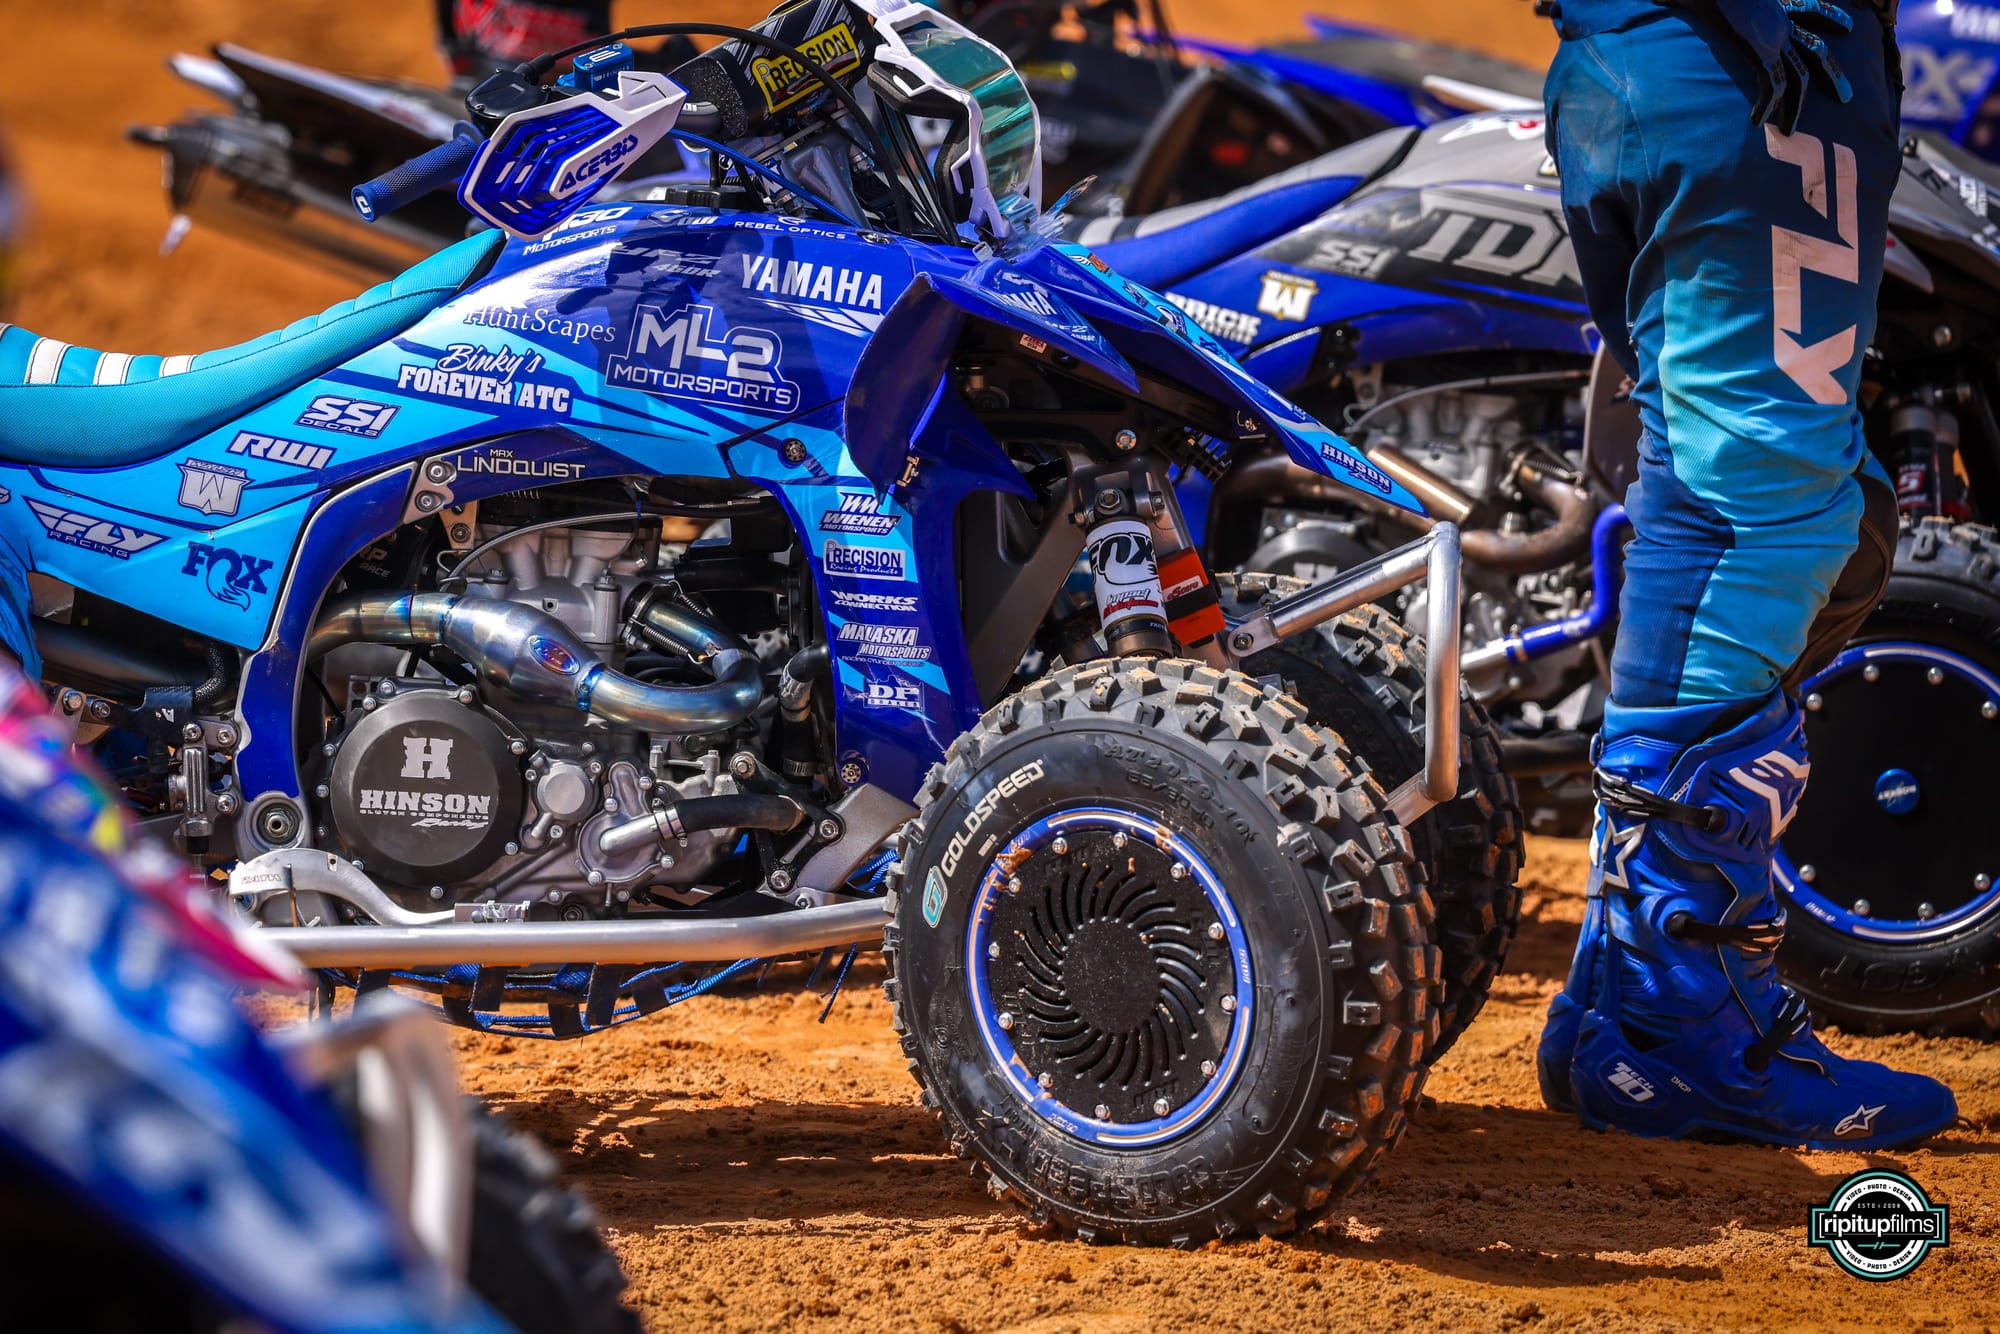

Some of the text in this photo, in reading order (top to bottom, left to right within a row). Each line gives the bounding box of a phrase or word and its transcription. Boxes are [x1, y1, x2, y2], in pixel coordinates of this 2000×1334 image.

[755, 30, 855, 95] PRECSION
[559, 134, 639, 193] ACERBIS
[522, 225, 617, 256] MOTORSPORTS
[734, 221, 846, 240] REBEL OPTICS
[741, 253, 882, 310] YAMAHA
[463, 306, 616, 345] HuntScapes
[635, 312, 775, 384] ML2
[438, 344, 543, 385] Binky's
[397, 365, 571, 413] FOREVER ATC
[613, 363, 792, 406] MOTORSPORTS
[299, 417, 379, 437] DECALS
[302, 397, 396, 431] SSI
[457, 455, 586, 478] LINDQUIST
[489, 448, 513, 458] MAX
[1323, 443, 1390, 487] HINSON
[45, 506, 165, 552] FLY
[822, 523, 888, 534] MOTORSPORTS
[823, 511, 898, 528] WIENEN
[50, 531, 128, 558] RACING
[826, 541, 901, 568] PRECISION
[181, 540, 274, 604] FOX
[830, 589, 919, 605] WORKS
[834, 599, 918, 612] CONNECTION
[839, 623, 917, 646] MALASKA
[860, 643, 930, 659] MOTORSPORTS
[868, 684, 920, 700] DP
[400, 736, 453, 780] H
[360, 789, 490, 814] HINSON
[940, 761, 1045, 878] GOLDSPEED
[1614, 1061, 1655, 1090] TECH
